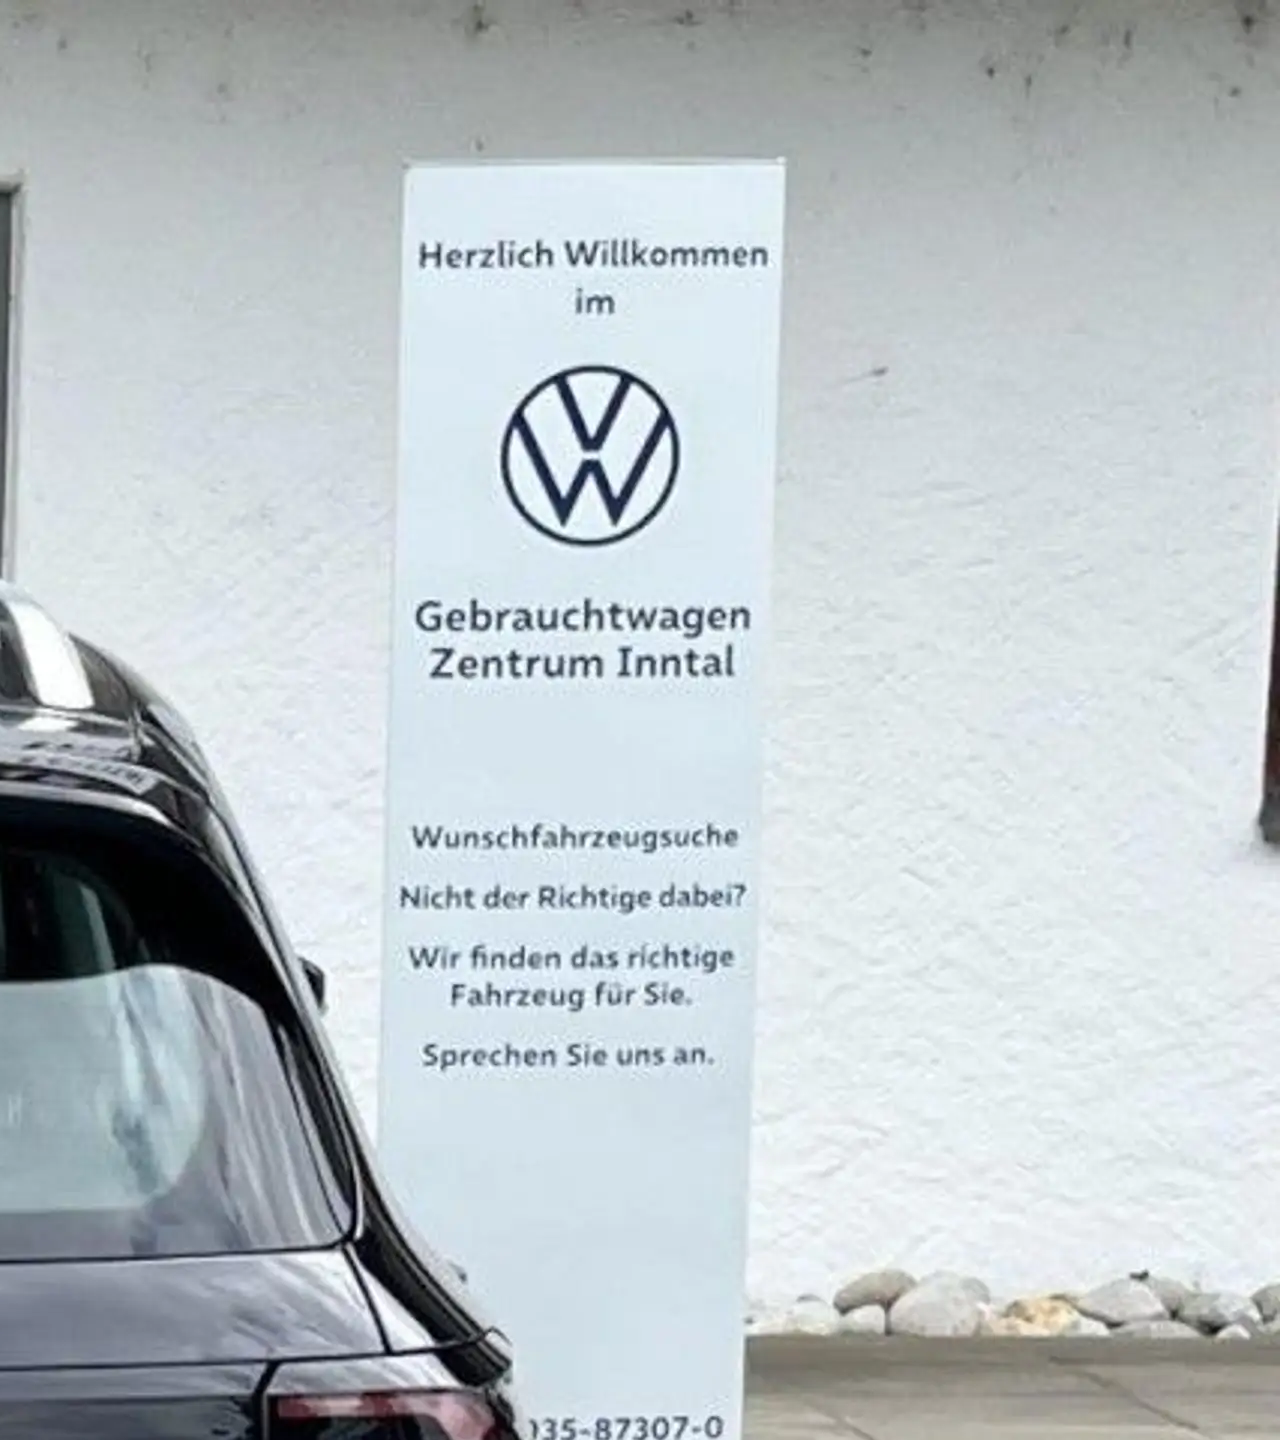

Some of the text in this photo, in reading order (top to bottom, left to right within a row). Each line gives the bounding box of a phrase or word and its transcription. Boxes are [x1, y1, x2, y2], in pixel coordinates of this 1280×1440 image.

[418, 239, 769, 269] Herzlich Willkommen
[575, 287, 615, 315] im
[414, 597, 752, 640] Gebrauchtwagen
[429, 643, 736, 680] Zentrum Inntal
[411, 823, 740, 854] Wunschfahrzeugsuche
[399, 882, 747, 915] Nicht der Richtige dabei?
[408, 943, 735, 973] Wir finden das richtige
[450, 981, 693, 1013] Fahrzeug für Sie.
[422, 1042, 715, 1071] Sprechen Sie uns an.
